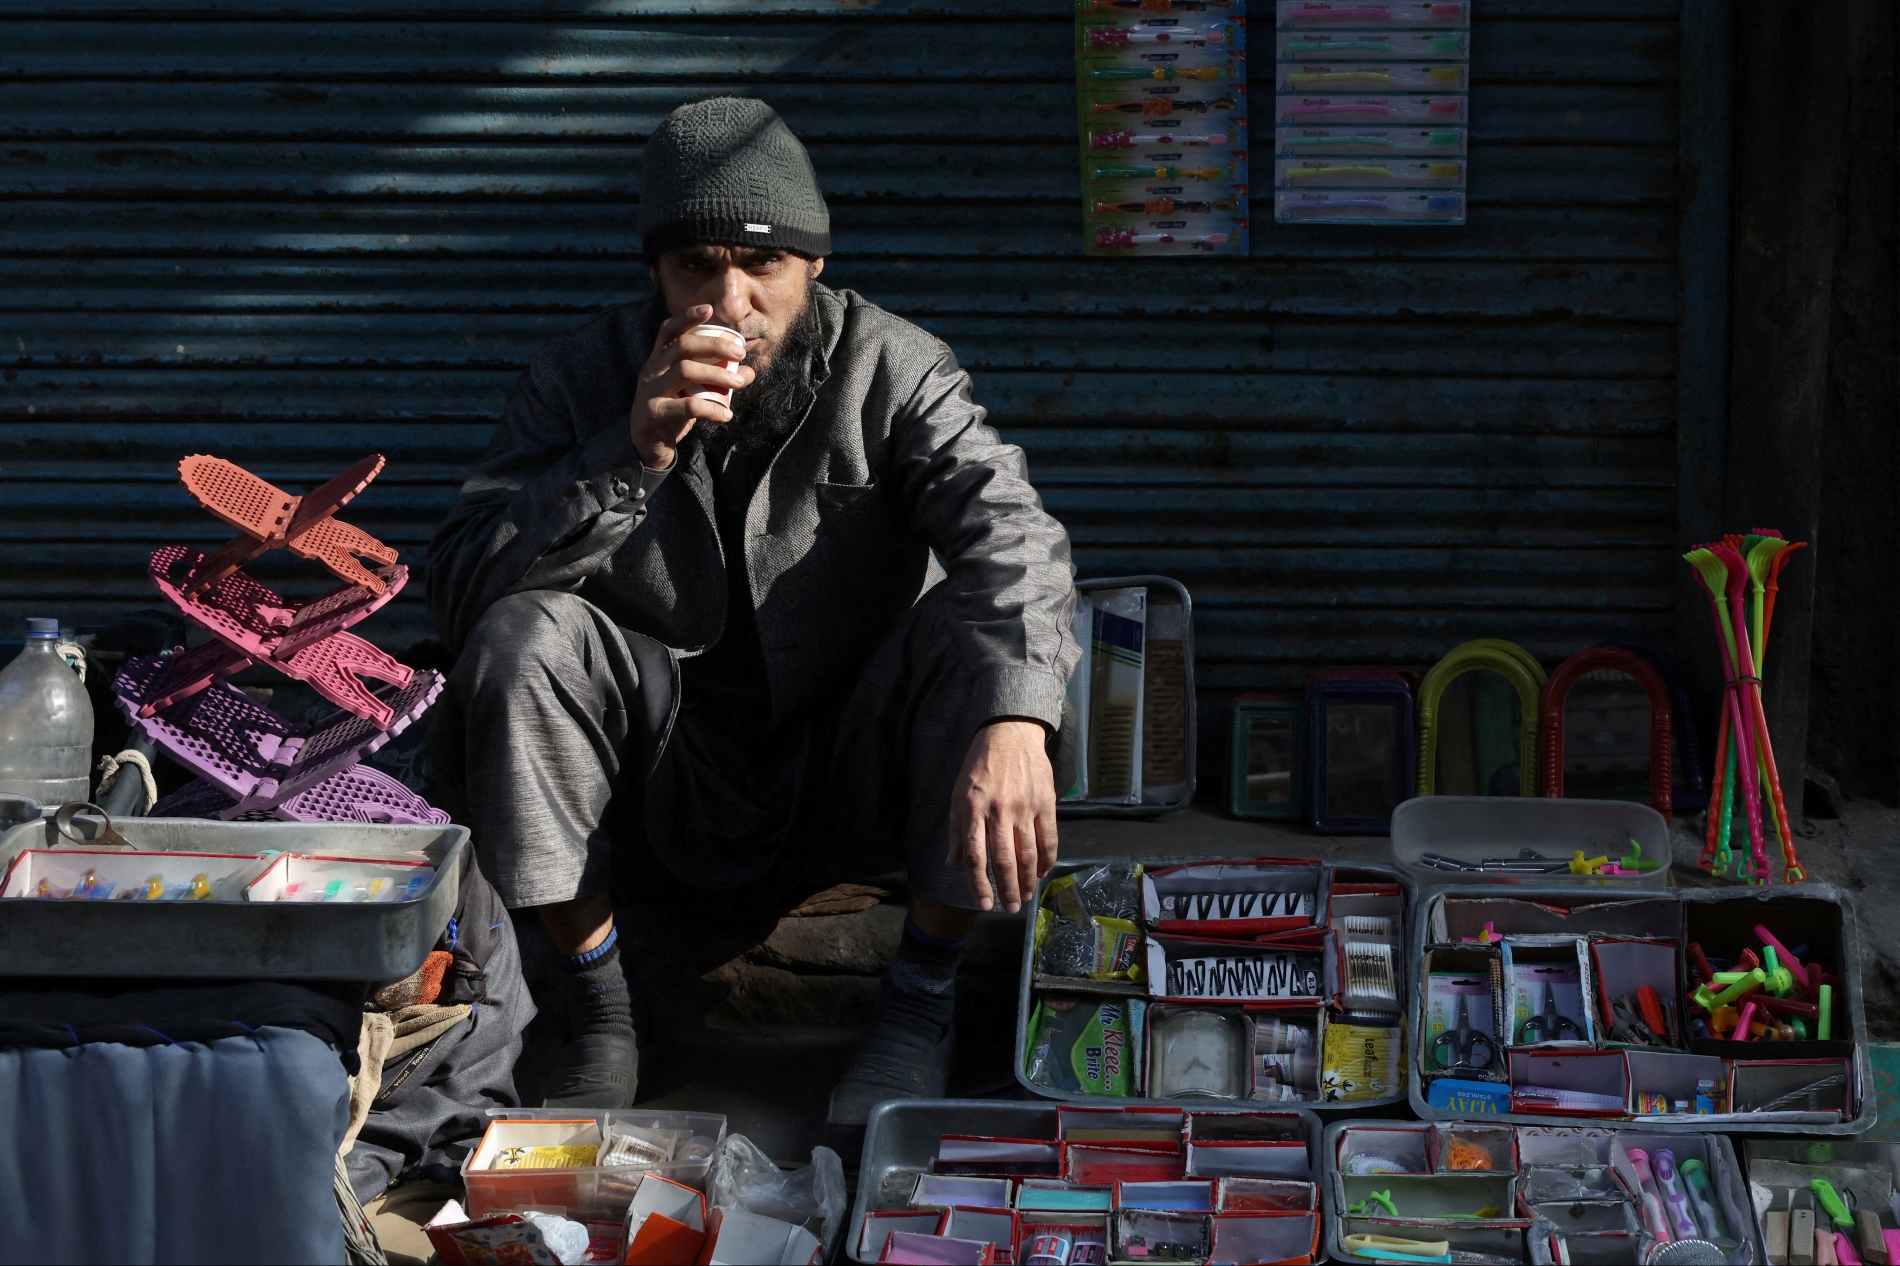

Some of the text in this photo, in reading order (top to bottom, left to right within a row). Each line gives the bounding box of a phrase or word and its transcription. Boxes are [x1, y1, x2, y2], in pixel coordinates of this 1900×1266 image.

[1127, 938, 1137, 951] SIR
[1349, 954, 1386, 962] 100PCS
[1308, 977, 1316, 989] R-1
[1099, 1000, 1122, 1026] Mr
[1085, 1046, 1102, 1080] Brite
[1457, 1091, 1491, 1100] STAINLESS
[1445, 1097, 1497, 1114] VIJAY
